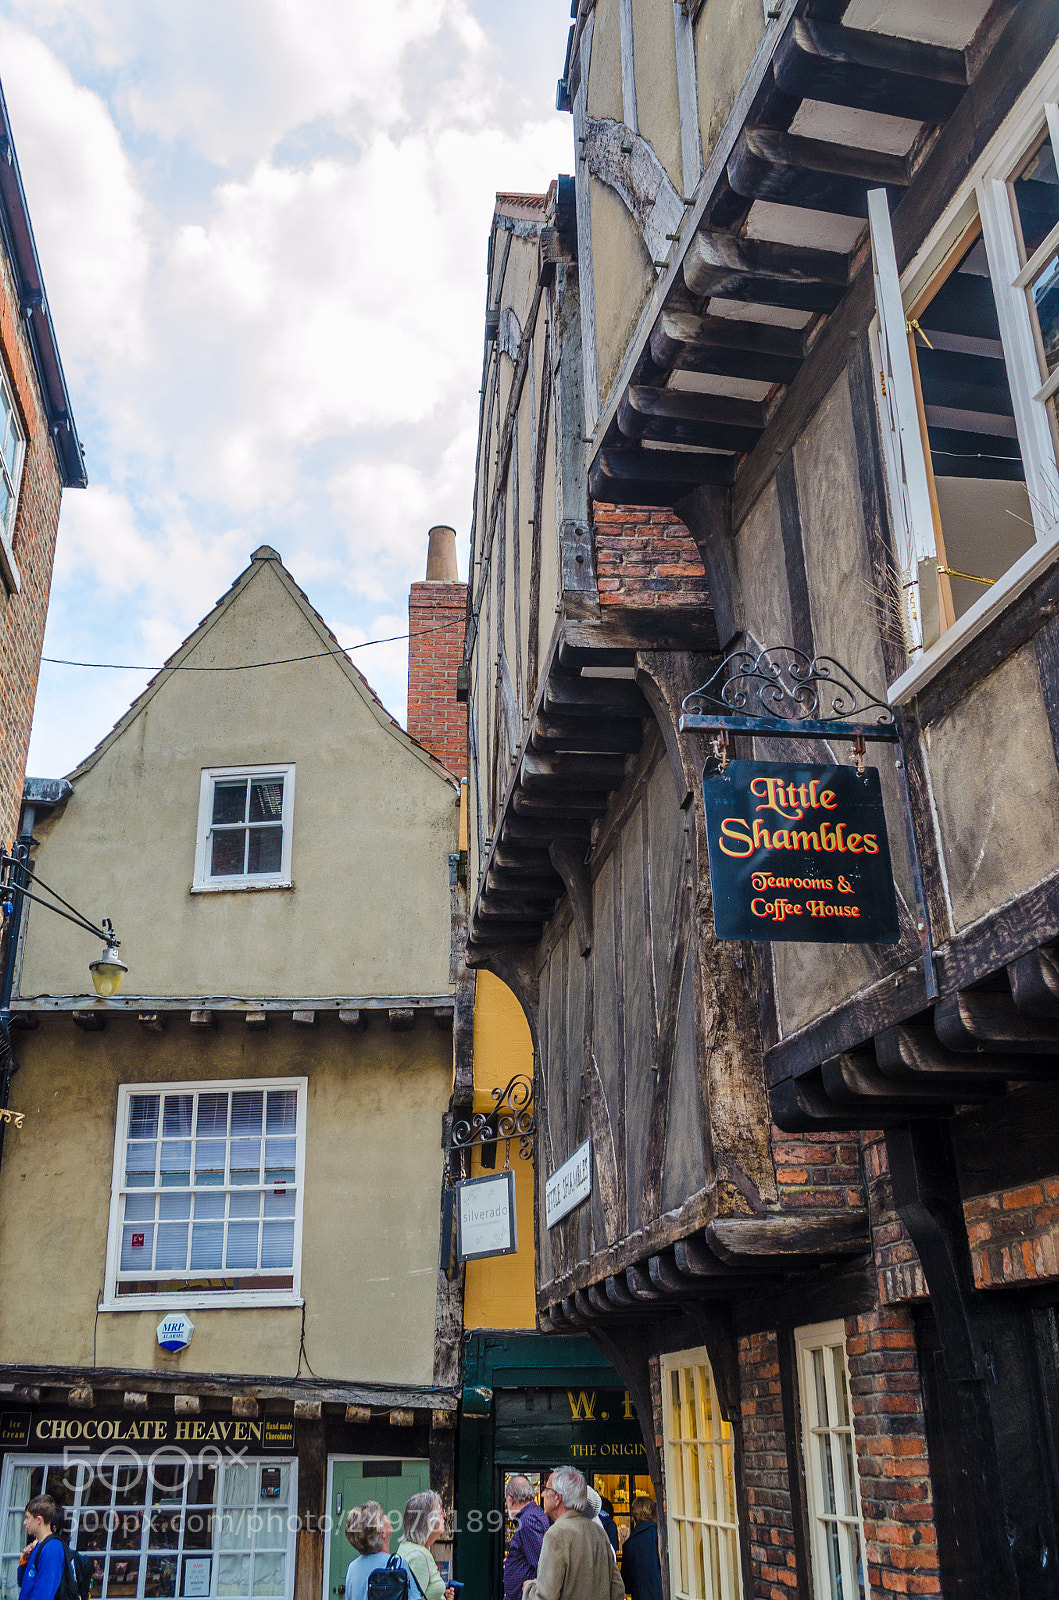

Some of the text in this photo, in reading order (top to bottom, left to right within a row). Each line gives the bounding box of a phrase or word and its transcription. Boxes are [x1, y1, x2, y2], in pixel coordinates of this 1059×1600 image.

[750, 777, 838, 820] Little
[718, 818, 880, 858] Shambles
[751, 871, 856, 894] Tearooms &
[750, 898, 861, 921] Coffee House
[463, 1205, 508, 1222] silverado
[162, 1323, 185, 1332] MRP
[9, 1419, 22, 1429] Ice
[35, 1419, 264, 1441] CHOCOLATE HEAVEN
[266, 1421, 293, 1430] Hand made
[2, 1429, 25, 1439] Cream
[265, 1431, 293, 1440] Chocolates
[570, 1444, 597, 1456] THE
